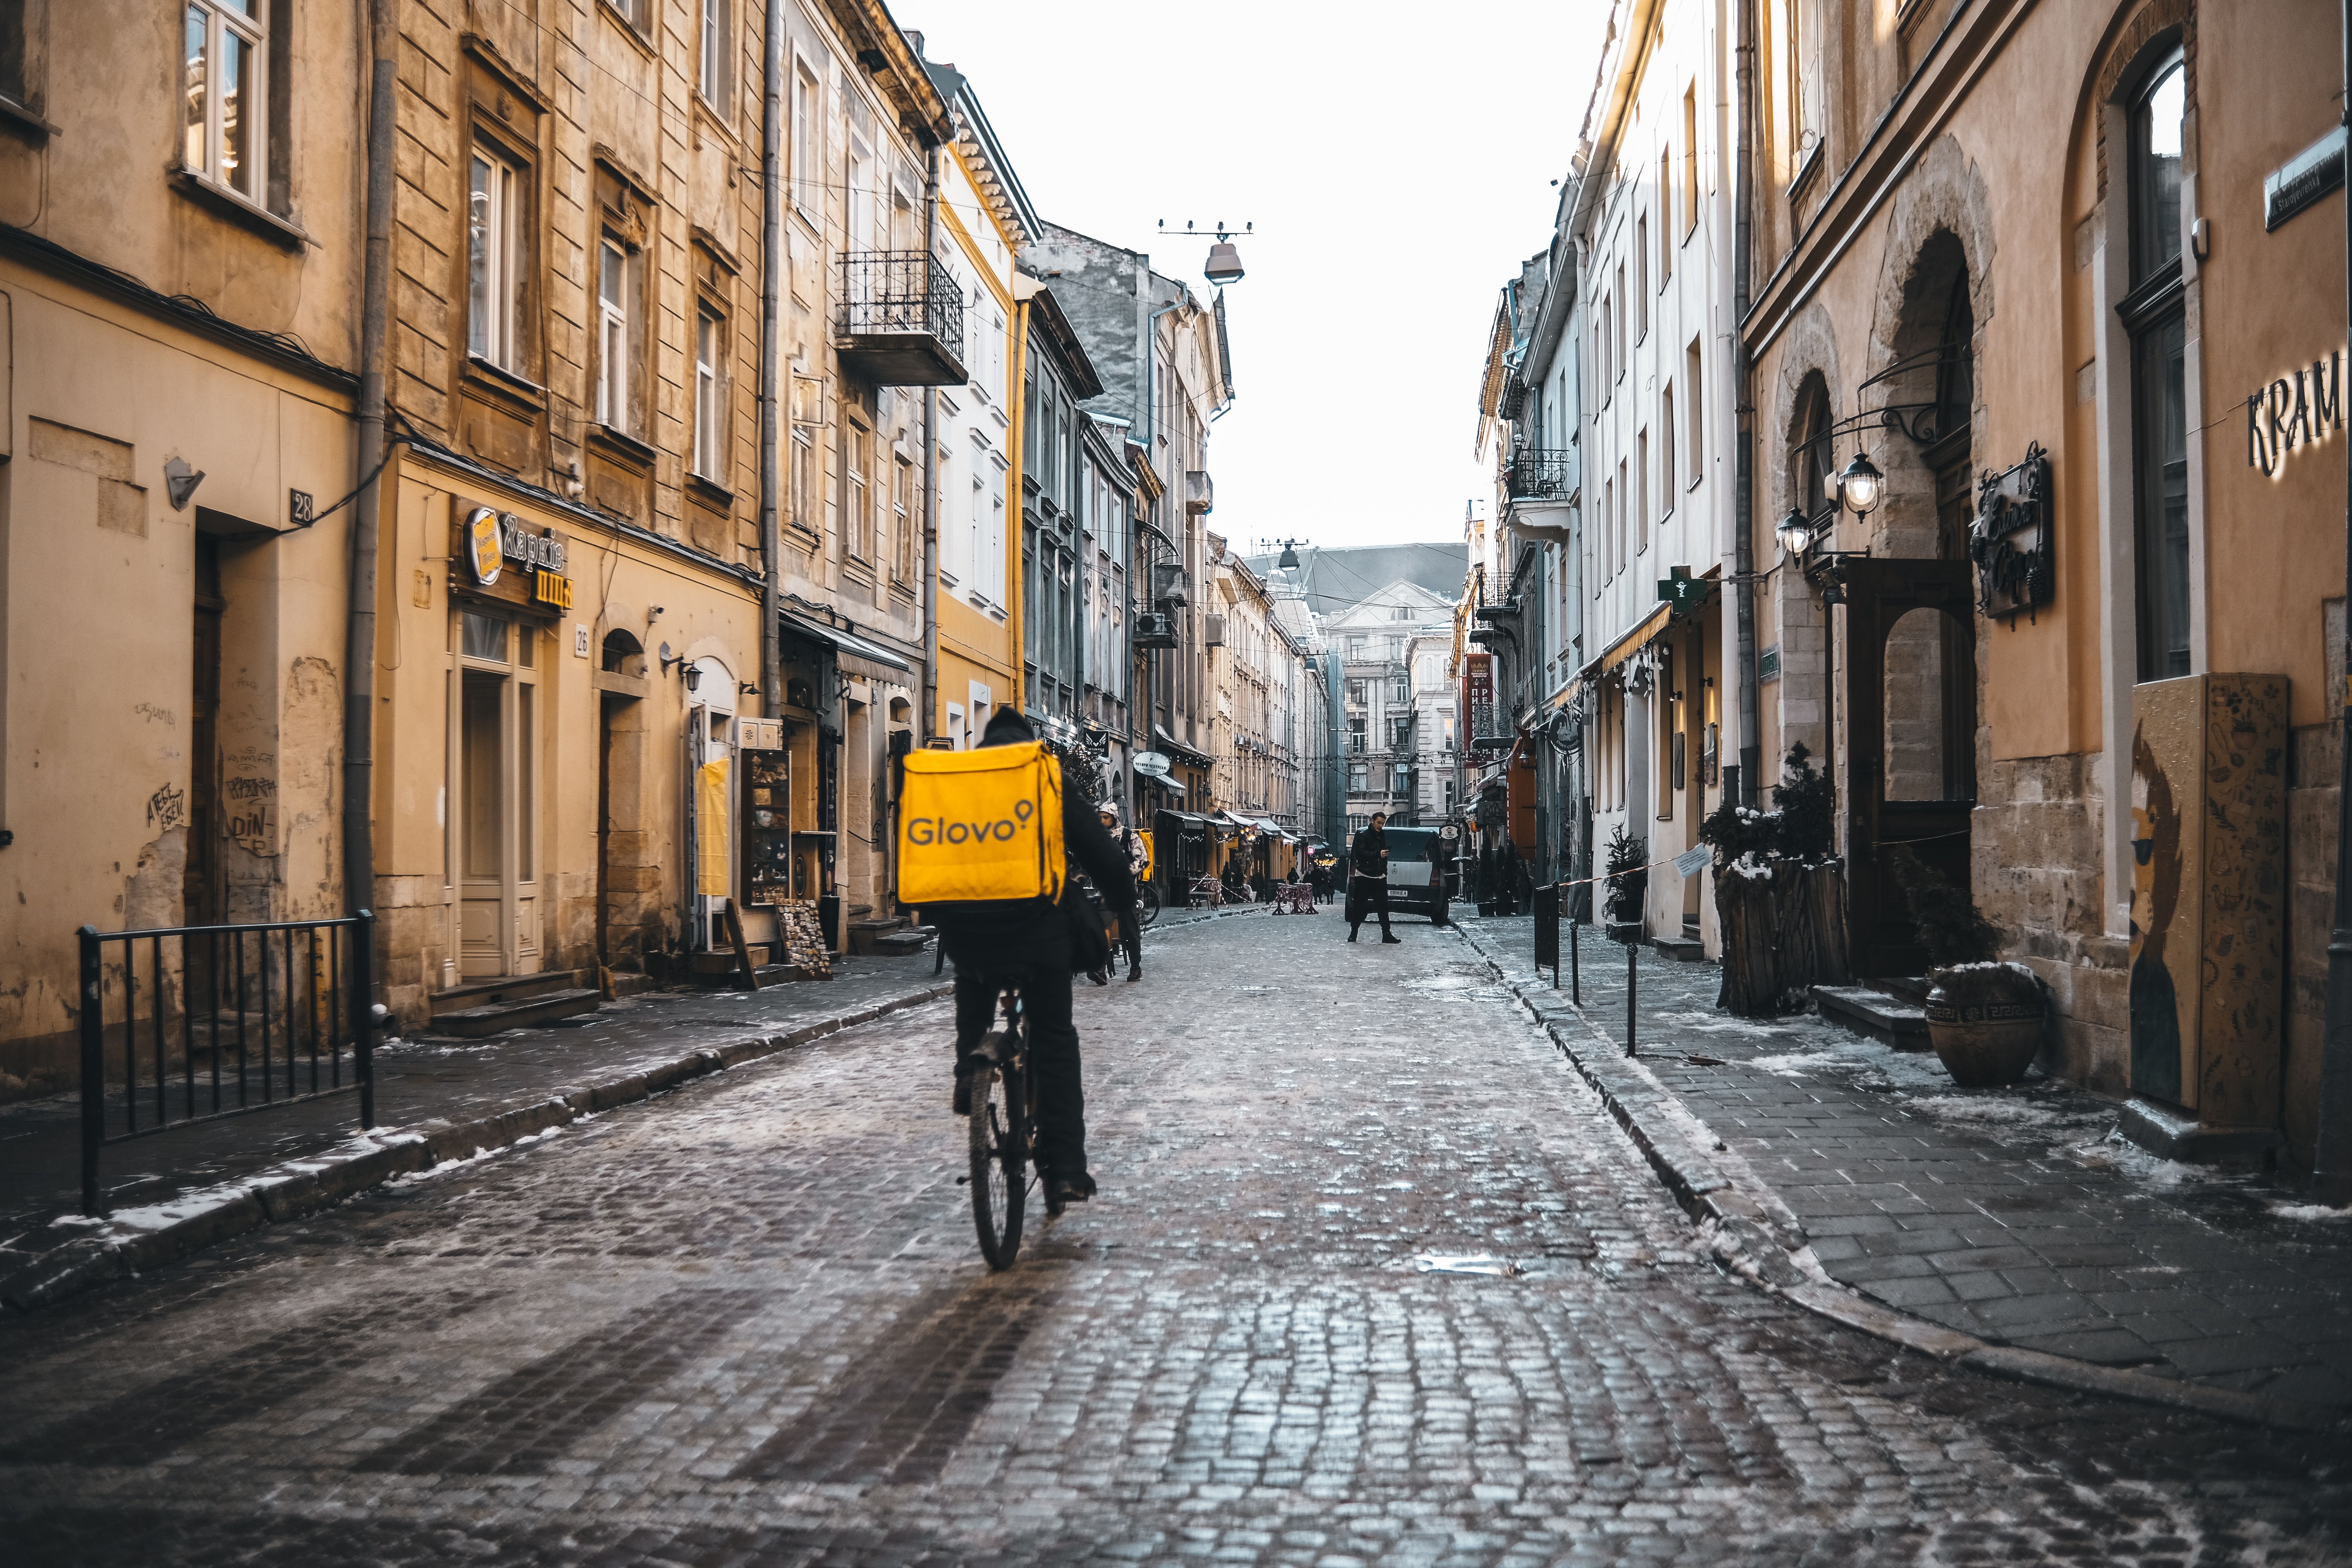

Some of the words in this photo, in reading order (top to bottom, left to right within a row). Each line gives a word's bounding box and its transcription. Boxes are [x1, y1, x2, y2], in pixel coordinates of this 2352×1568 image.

[2247, 351, 2341, 477] KRAM
[295, 493, 311, 521] 28
[504, 514, 564, 573] Харків
[578, 630, 587, 652] 26
[907, 817, 1015, 845] Glovo
